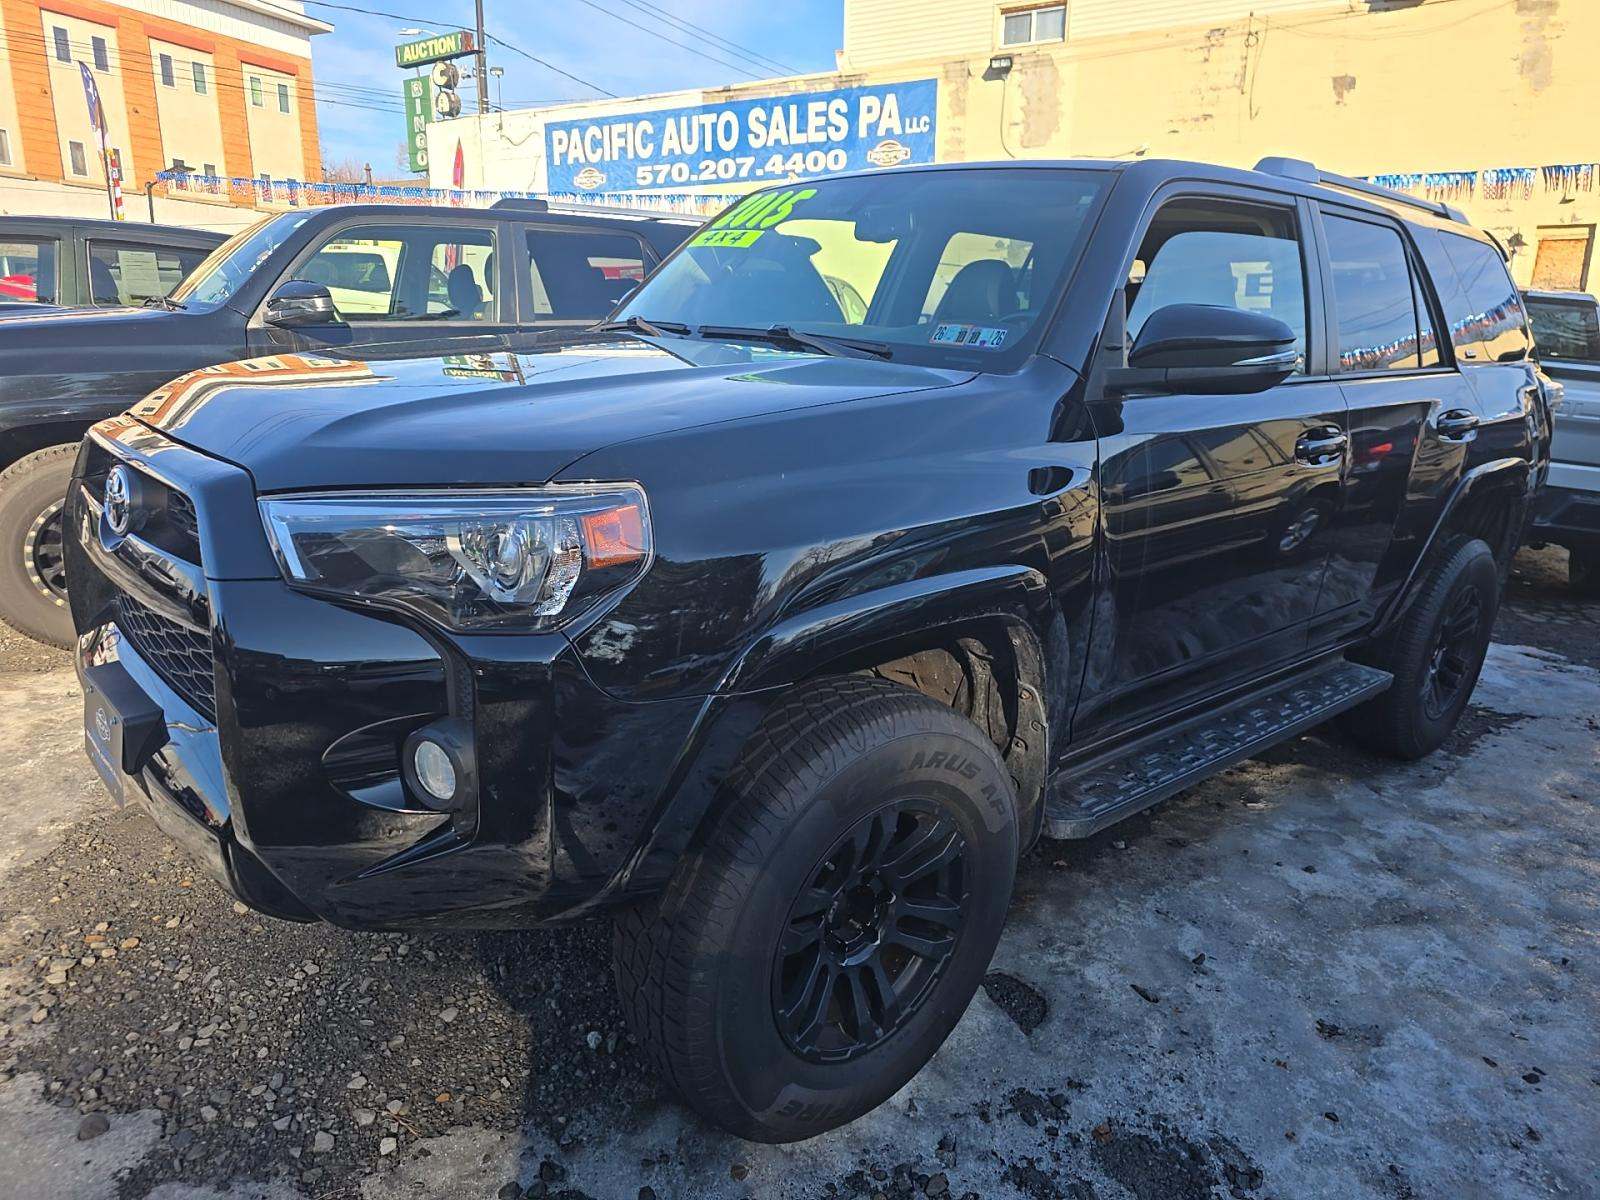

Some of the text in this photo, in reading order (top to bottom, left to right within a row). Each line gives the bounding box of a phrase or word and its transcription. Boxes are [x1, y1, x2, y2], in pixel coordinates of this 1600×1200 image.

[404, 35, 457, 61] AUCTION
[410, 81, 428, 167] BINGO
[552, 93, 930, 166] PACIFIC AUTO SALES PA LLC
[636, 148, 848, 186] 570.207.4400
[711, 188, 818, 229] 2015
